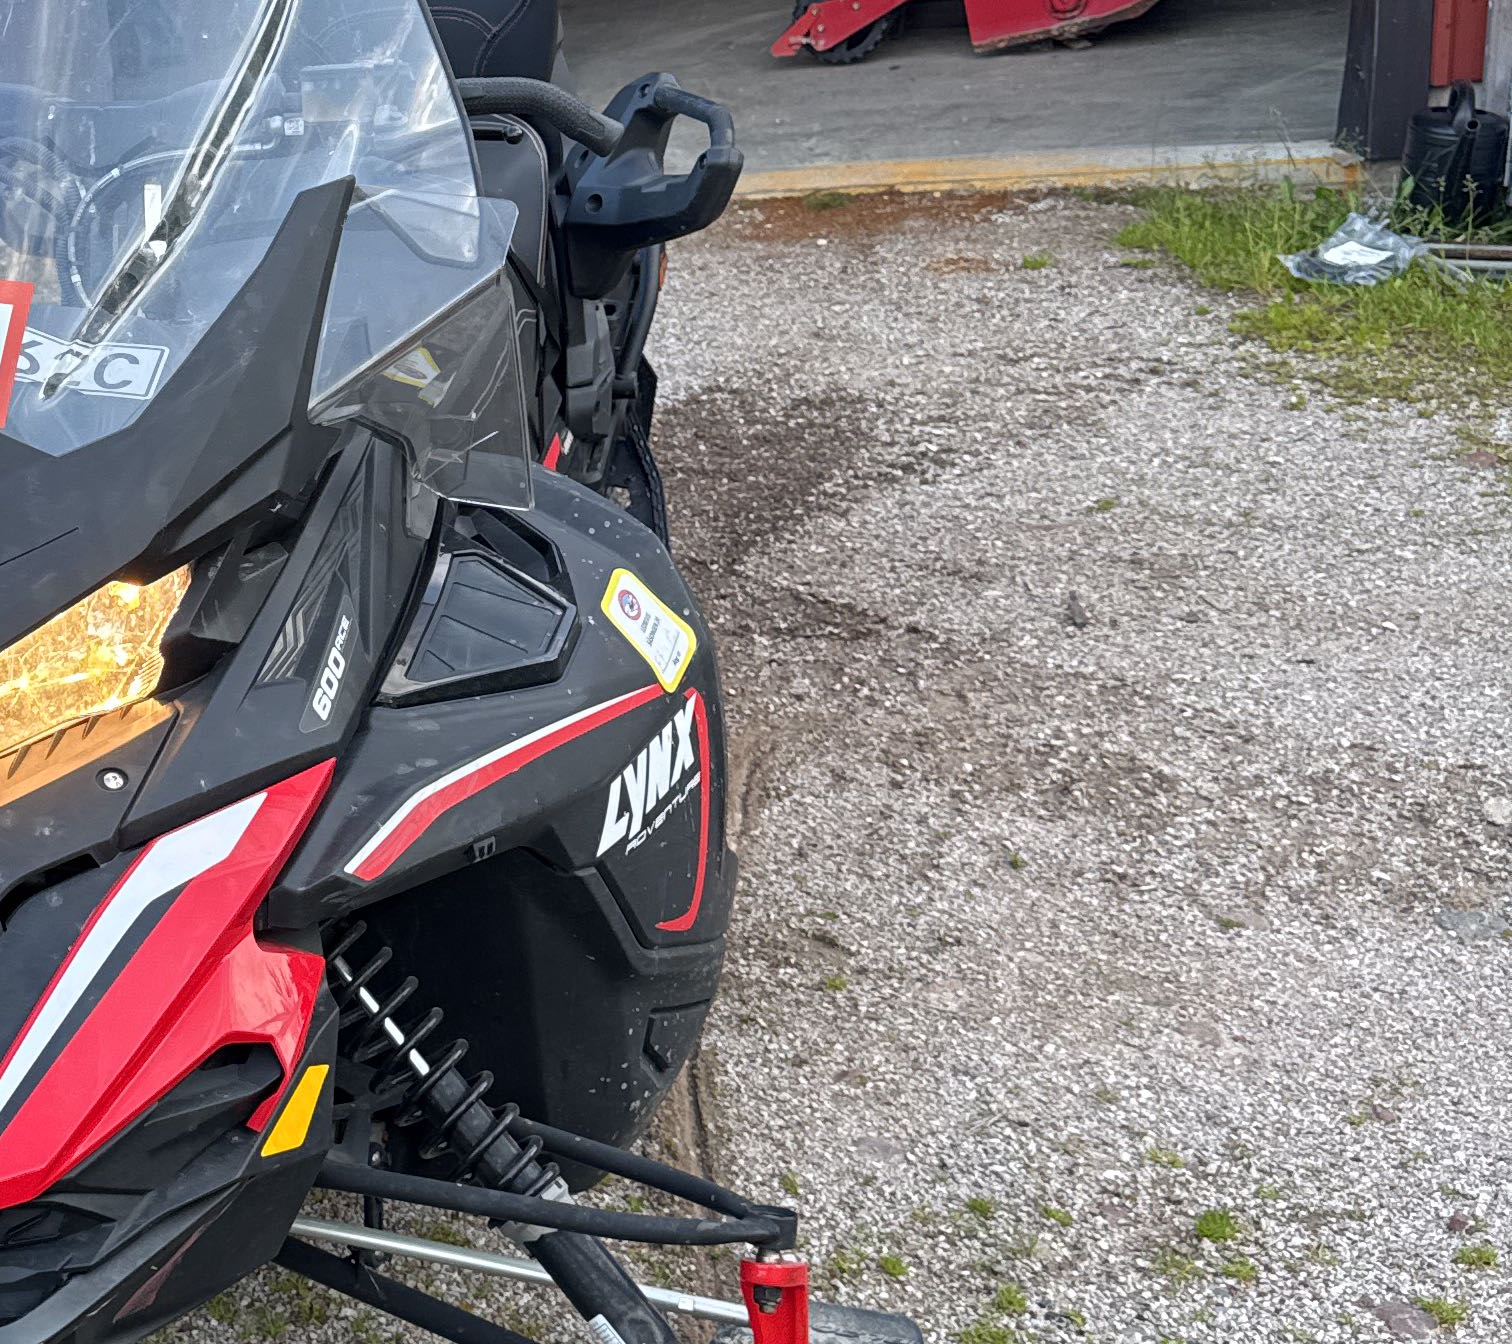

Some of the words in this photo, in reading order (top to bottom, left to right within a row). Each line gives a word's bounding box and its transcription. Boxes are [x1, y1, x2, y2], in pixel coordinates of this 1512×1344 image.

[312, 646, 346, 721] 600
[596, 691, 697, 858] LYNX
[625, 770, 702, 856] ADVENTURE
